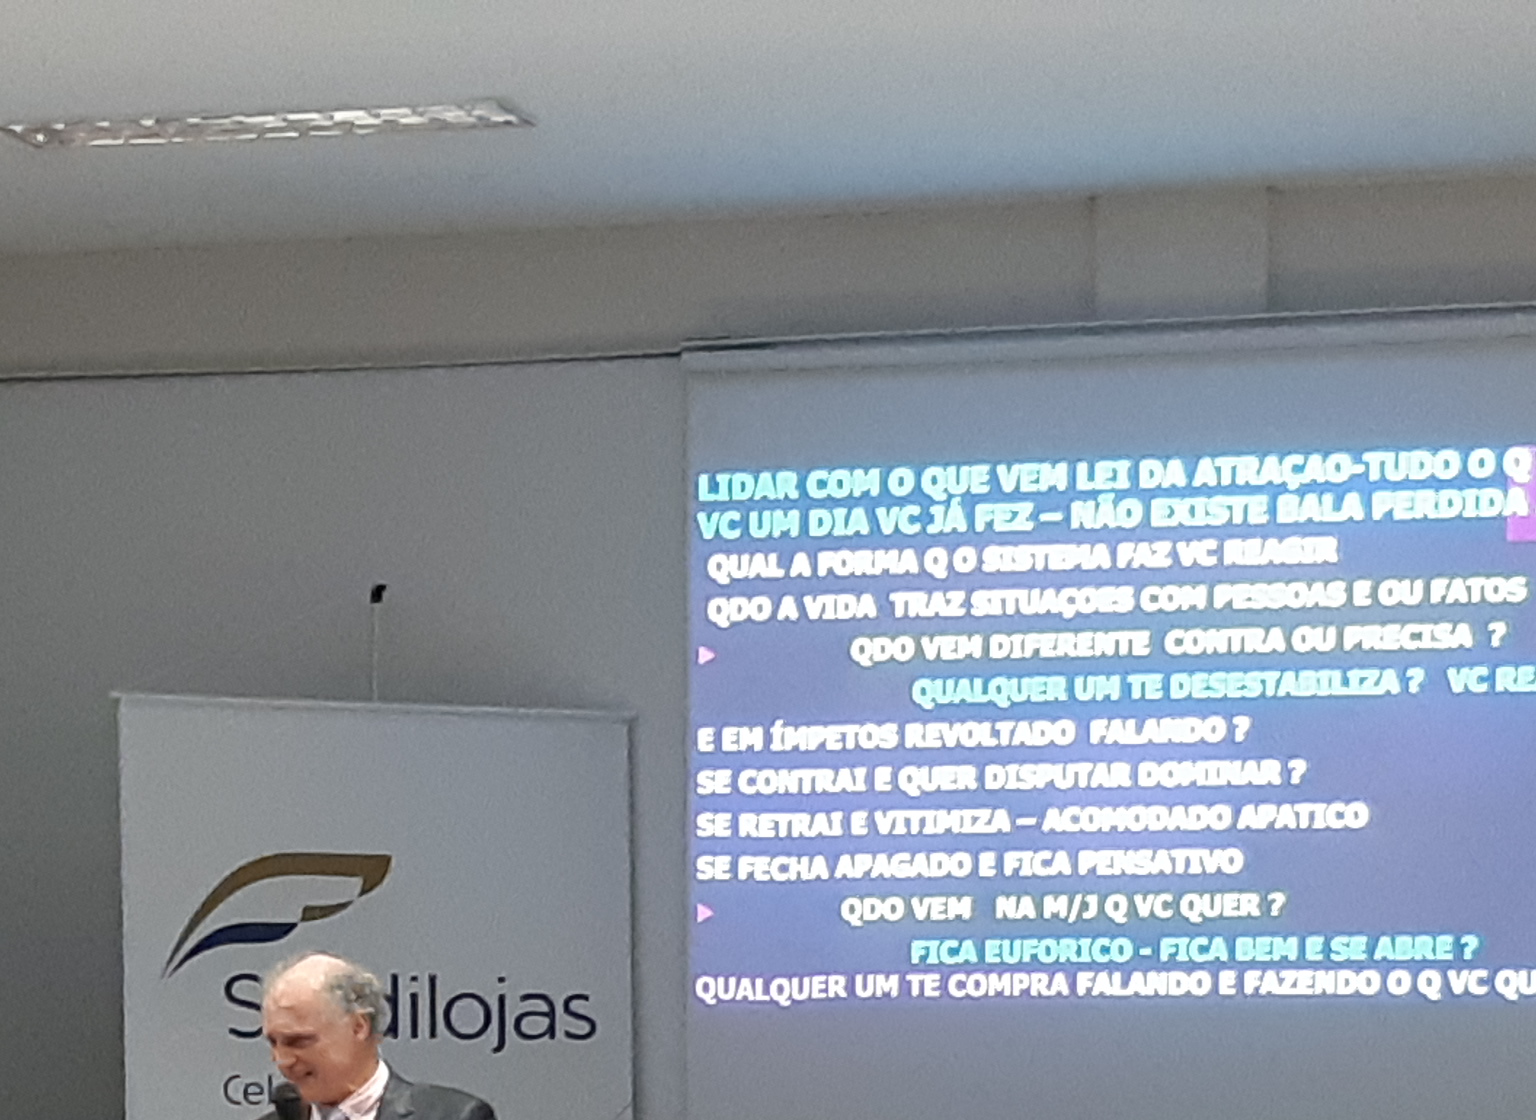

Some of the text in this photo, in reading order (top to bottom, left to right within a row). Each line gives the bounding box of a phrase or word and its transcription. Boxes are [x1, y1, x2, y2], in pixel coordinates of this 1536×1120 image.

[697, 470, 800, 503] LIDAR
[805, 467, 881, 500] COM
[886, 466, 916, 498] O
[919, 463, 992, 502] QUE
[995, 461, 1069, 494] VEM
[1074, 458, 1133, 492] LEI
[1137, 457, 1189, 490] DA
[1466, 446, 1498, 480] O
[1501, 445, 1534, 485] Q
[695, 509, 742, 541] VC
[748, 508, 801, 539] UM
[807, 505, 871, 538] DIA
[874, 503, 923, 536] VC
[925, 496, 969, 535] JÁ
[973, 500, 1036, 534] FEZ
[1069, 491, 1145, 531] NÃO
[1149, 493, 1271, 529] EXISTE
[1275, 490, 1366, 525] BALA
[1370, 488, 1531, 522] PERDIDA
[706, 534, 1340, 586] QUAL A FORMA Q O SISTEMA FAZ VC REAGIR
[706, 594, 774, 629] QDO
[776, 594, 800, 622] A
[801, 592, 878, 621] VIDA
[888, 589, 968, 619] TRAZ
[1138, 583, 1209, 614] COM
[1212, 579, 1349, 611] PESSOAS
[1351, 578, 1374, 608] E
[1376, 577, 1425, 608] OU
[1428, 574, 1529, 605] FATOS
[849, 620, 1508, 668] QDO VEM DIFERENTE CONTRA OU PRECISA ?
[910, 674, 1070, 711] QUALQUER
[1072, 673, 1122, 702] UM
[1125, 671, 1165, 701] TE
[1168, 667, 1403, 701] DESESTABILIZA
[1404, 665, 1427, 695] ?
[1445, 665, 1490, 695] VC
[696, 714, 1252, 753] E EM ÍMPETOS REVOLTADO FALANDO ?
[695, 757, 1309, 798] SE CONTRAI E QUER DISPUTAR DOMINAR ?
[695, 810, 733, 839] SE
[737, 809, 845, 839] RETRAI
[849, 809, 870, 837] E
[873, 807, 1012, 836] VITIMIZA
[1040, 802, 1234, 834] ACOMODADO
[1235, 799, 1371, 831] APATICO
[695, 846, 1246, 883] SE FECHA APAGADO E FICA PENSATIVO
[839, 895, 906, 928] QDO
[909, 894, 974, 922] VEM
[994, 894, 1038, 921] NA
[1103, 892, 1130, 925] Q
[1132, 891, 1175, 920] VC
[1178, 891, 1262, 924] QUER
[1266, 890, 1287, 918] ?
[909, 938, 980, 966] FICA
[983, 936, 1135, 966] EUFORICO
[1158, 935, 1230, 964] FICA
[1234, 935, 1300, 963] BEM
[1304, 934, 1326, 962] E
[1328, 934, 1369, 963] SE
[1372, 933, 1455, 962] ABRE
[1459, 933, 1480, 961] ?
[694, 973, 849, 1008] QUALQUER
[854, 972, 900, 999] UM
[904, 972, 942, 998] TE
[946, 971, 1071, 999] COMPRA
[1075, 969, 1213, 998] FALANDO
[1217, 968, 1239, 996] E
[1242, 968, 1383, 997] FAZENDO
[1385, 968, 1413, 997] O
[1415, 967, 1443, 1002] Q
[1445, 967, 1490, 996] VC
